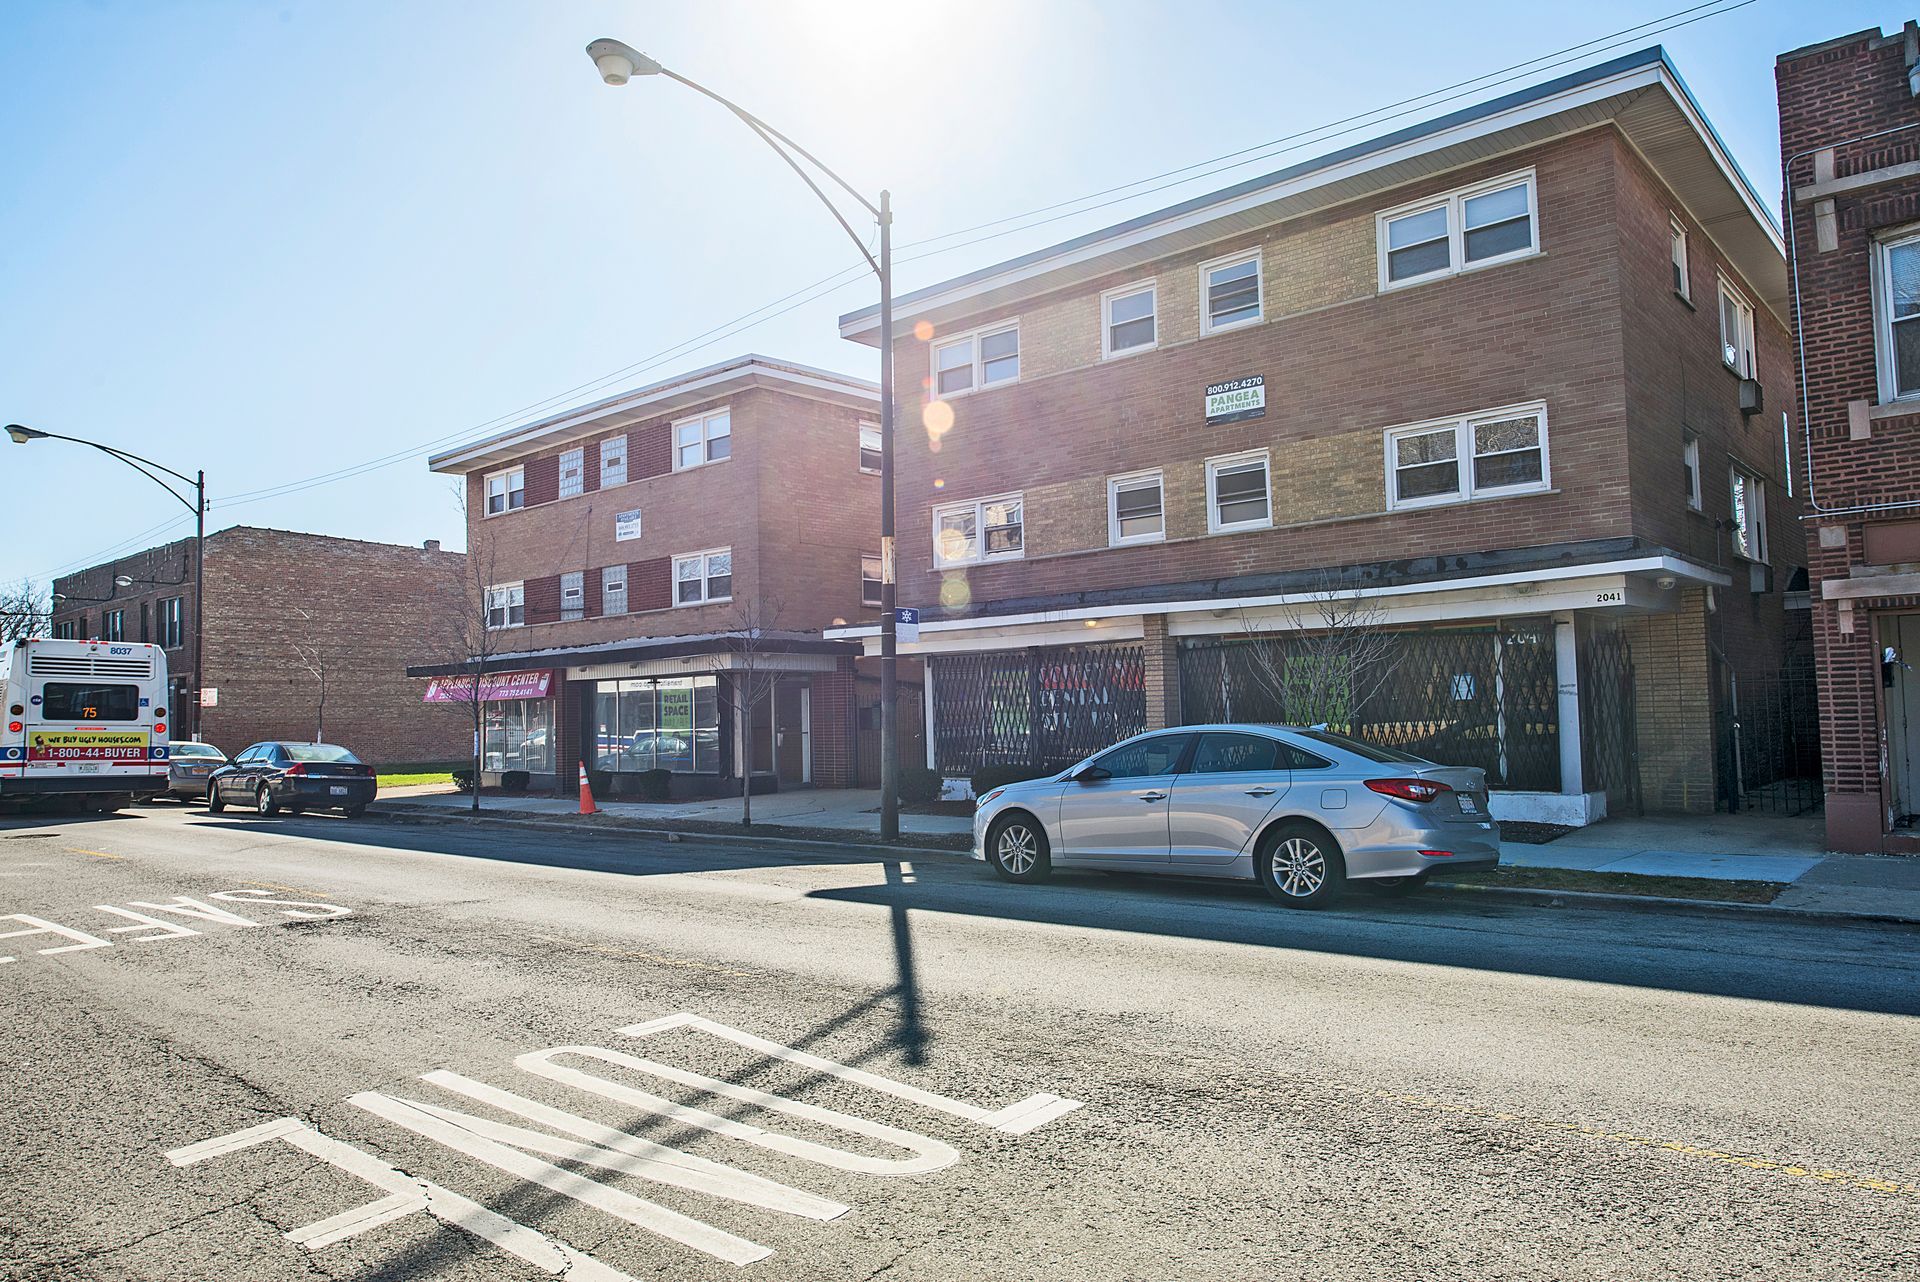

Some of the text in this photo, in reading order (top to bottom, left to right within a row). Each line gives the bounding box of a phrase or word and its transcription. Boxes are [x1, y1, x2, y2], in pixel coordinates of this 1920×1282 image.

[1207, 376, 1262, 395] 800.912.4270
[1210, 389, 1260, 407] PANGEA
[1210, 398, 1261, 415] APARTMENTS
[1596, 592, 1621, 602] 2041
[110, 647, 132, 656] 8037
[511, 672, 540, 686] CENTER
[663, 694, 689, 704] RETAIL
[82, 707, 97, 718] 75
[663, 705, 689, 717] SPACE
[48, 736, 142, 744] WE BUY UGLY HOUSES.COM
[48, 747, 141, 758] 1-800-44-BUYER
